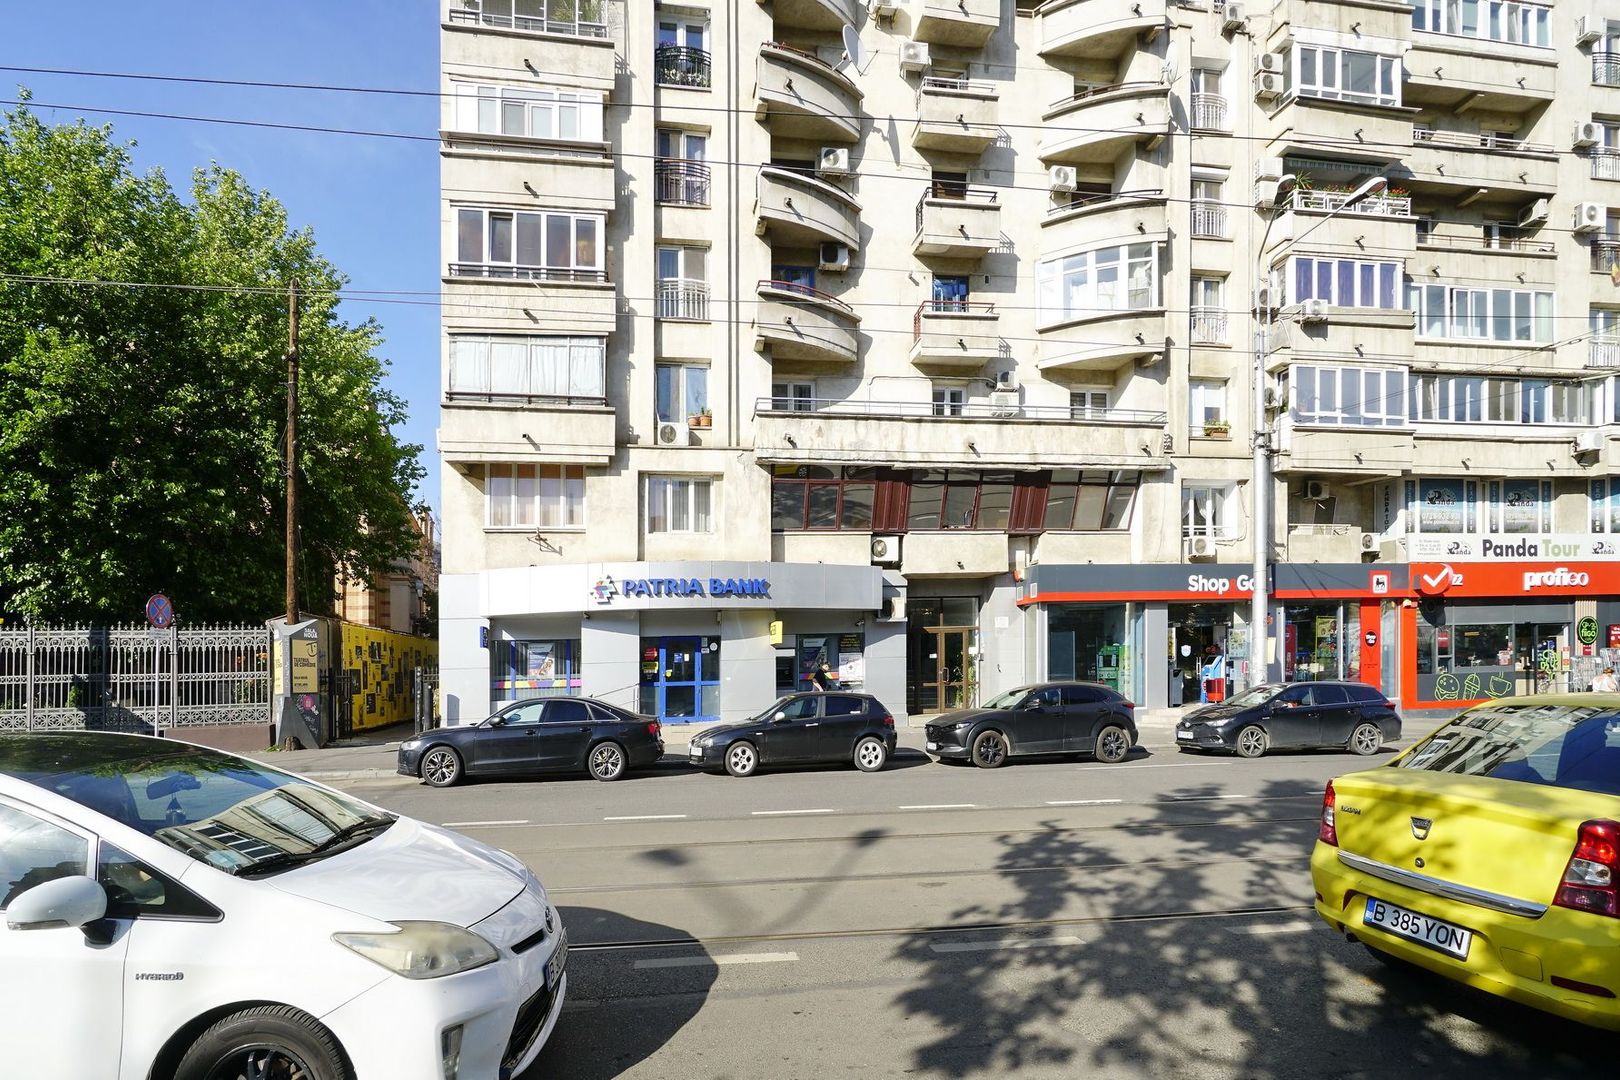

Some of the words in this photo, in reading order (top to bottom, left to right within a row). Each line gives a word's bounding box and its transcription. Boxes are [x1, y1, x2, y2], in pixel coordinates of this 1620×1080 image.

[1482, 537, 1538, 557] Panda
[1542, 538, 1580, 557] Tour
[622, 578, 703, 596] PATRIA
[709, 577, 769, 597] BANK
[1188, 574, 1229, 595] Shop
[1373, 903, 1386, 922] B
[1390, 909, 1420, 935] 385
[1424, 919, 1465, 951] YON
